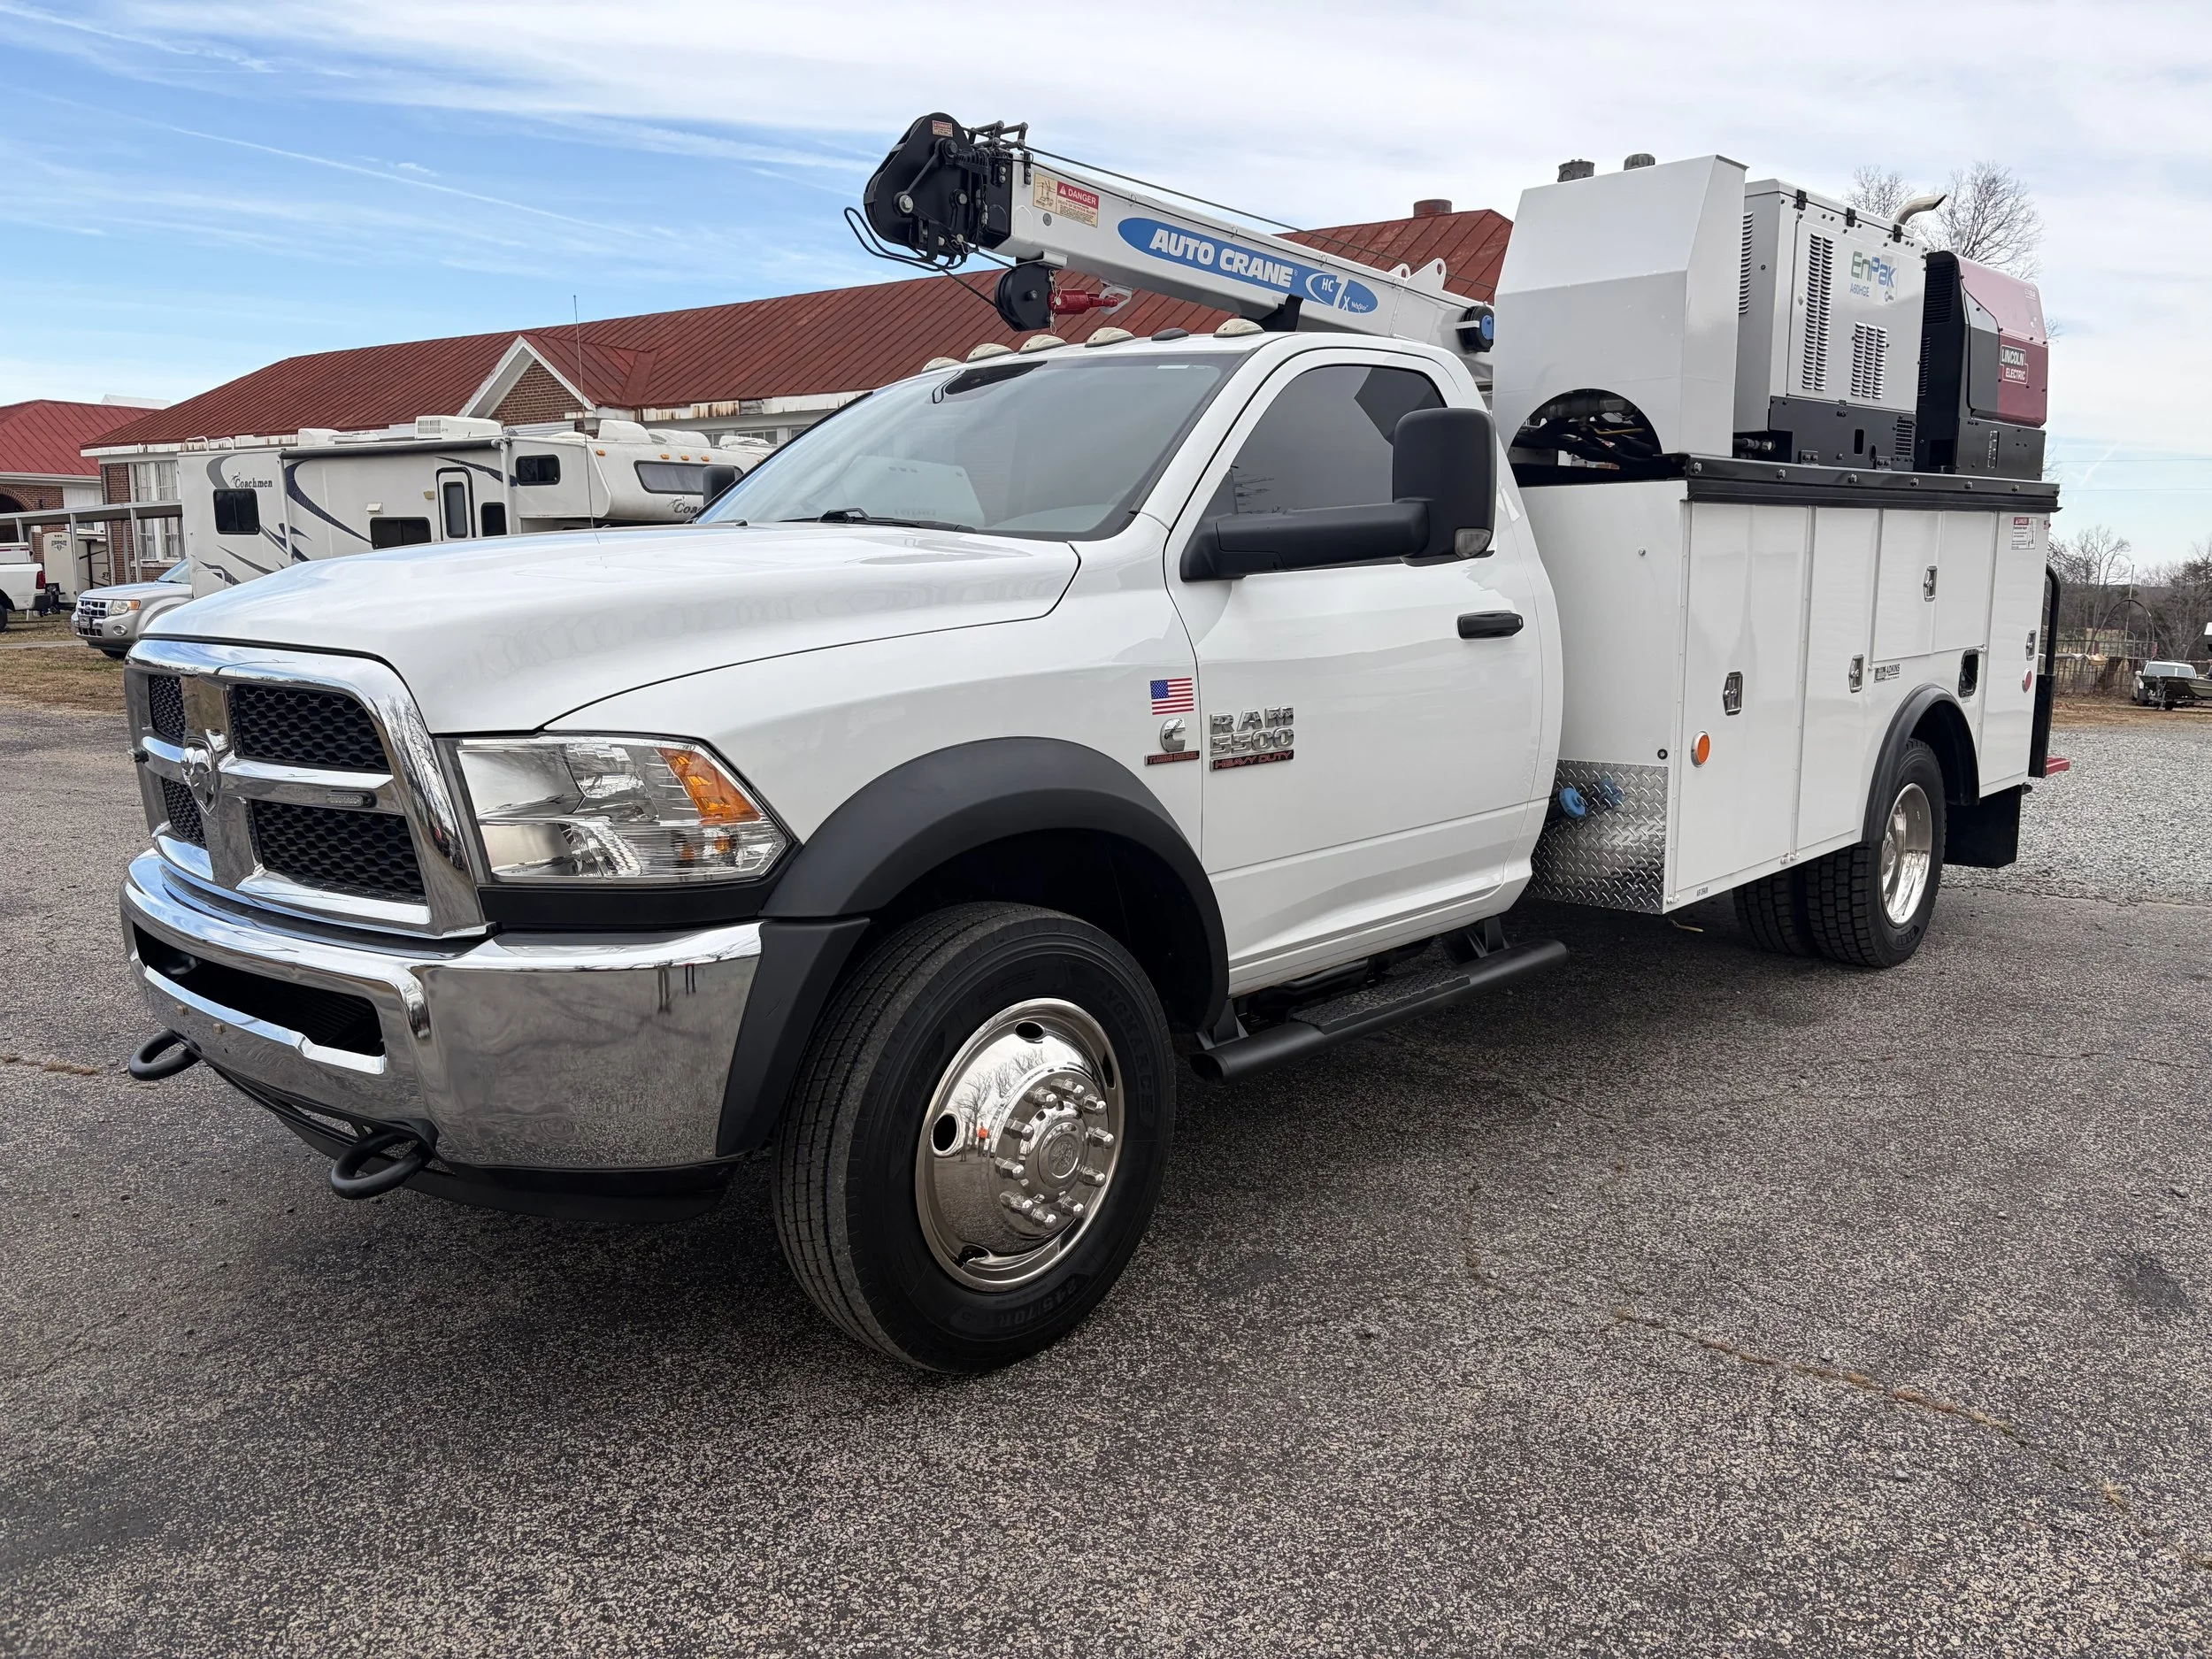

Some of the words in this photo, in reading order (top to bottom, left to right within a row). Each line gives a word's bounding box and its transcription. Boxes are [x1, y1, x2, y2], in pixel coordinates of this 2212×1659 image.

[1068, 188, 1096, 205] DANGER
[1149, 228, 1215, 265] AUTO
[1219, 248, 1294, 288] CRANE
[1851, 250, 1897, 288] EnPak
[1321, 277, 1334, 293] HC
[2001, 349, 2024, 366] LINCOLN
[2005, 367, 2025, 380] ELECTRIC
[234, 477, 273, 488] Coachmen
[1210, 707, 1294, 734] RAM
[1210, 727, 1294, 757] 5500
[1215, 756, 1255, 769] HEAVY
[1258, 751, 1291, 763] DUTY
